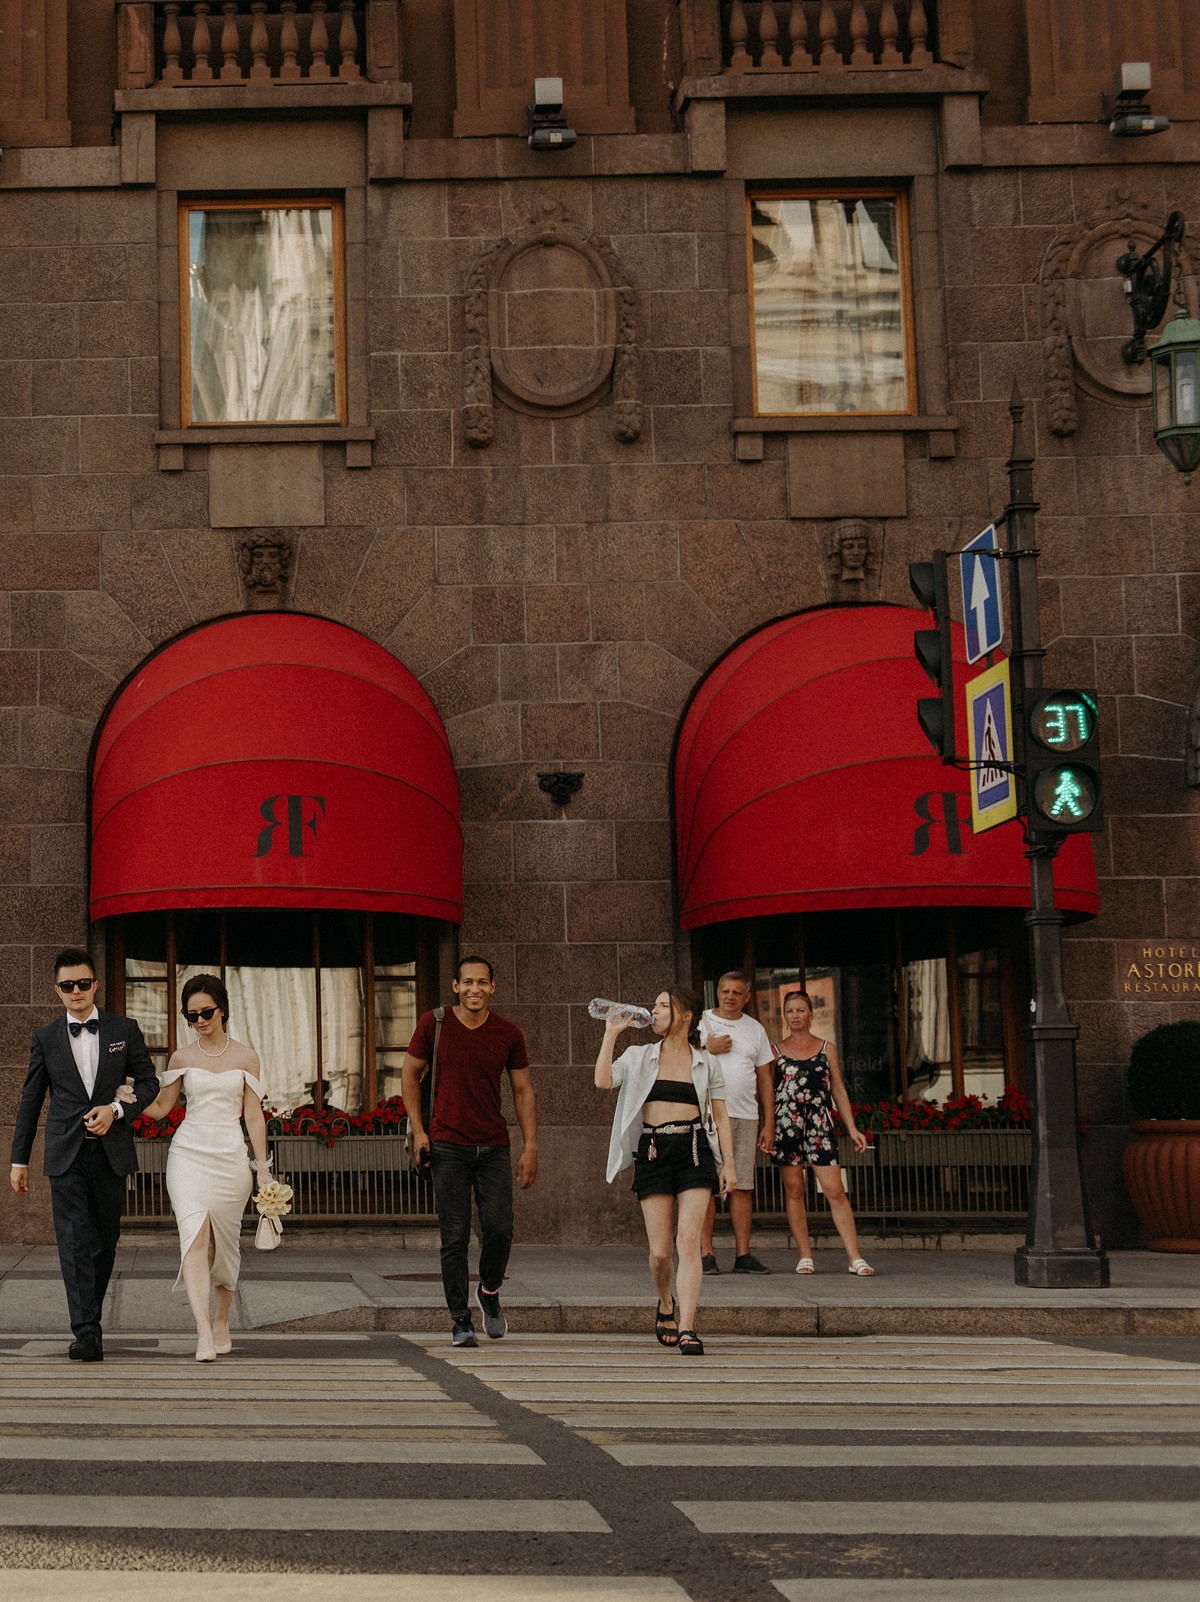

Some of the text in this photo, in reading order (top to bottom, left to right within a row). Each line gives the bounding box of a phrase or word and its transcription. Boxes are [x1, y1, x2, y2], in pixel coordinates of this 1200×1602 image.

[1044, 704, 1088, 743] 37
[1142, 947, 1200, 958] HOTEL
[1124, 982, 1200, 993] RESTAURA
